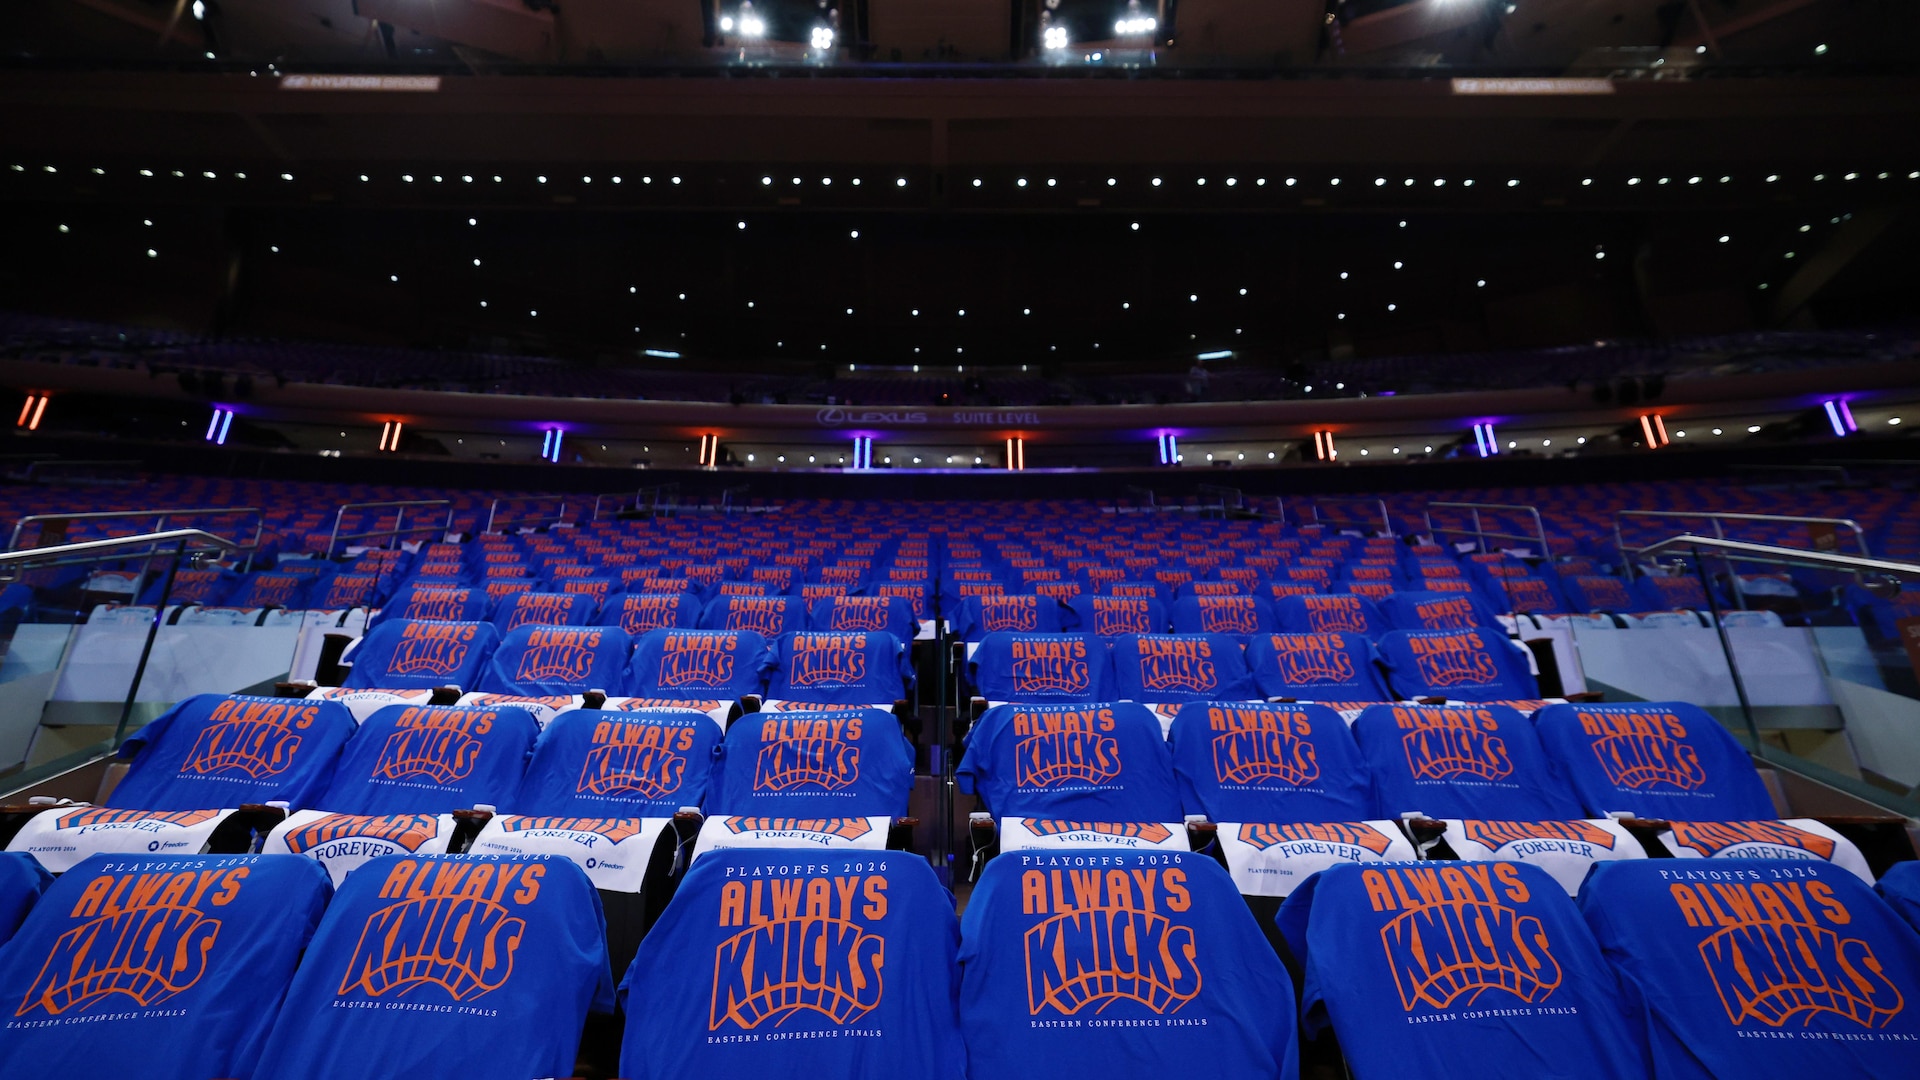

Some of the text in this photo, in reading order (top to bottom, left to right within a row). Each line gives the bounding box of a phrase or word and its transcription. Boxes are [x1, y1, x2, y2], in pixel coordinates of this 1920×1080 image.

[848, 412, 1040, 424] LEXUS SUITE LEVEL
[411, 590, 470, 603] ALWAYS
[516, 594, 574, 609] ALWAYS
[624, 597, 679, 610] ALWAYS
[729, 599, 786, 612] ALWAYS
[835, 595, 890, 607] ALWAYS
[981, 595, 1037, 607] ALWAYS
[1092, 599, 1149, 612] ALWAYS
[1199, 597, 1255, 610] ALWAYS
[1304, 597, 1361, 610] ALWAYS
[830, 605, 888, 632] KNICKS
[982, 604, 1037, 632] KNICKS
[1416, 600, 1473, 619] ALWAYS
[403, 623, 478, 641] ALWAYS
[527, 630, 601, 648] ALWAYS
[664, 635, 737, 651] ALWAYS
[793, 635, 866, 651] ALWAYS
[1271, 634, 1345, 651] ALWAYS
[1409, 632, 1484, 654] ALWAYS
[387, 636, 468, 675] KNICKS
[1012, 641, 1087, 658] ALWAYS
[1137, 638, 1211, 658] ALWAYS
[516, 643, 594, 682] KNICKS
[657, 647, 734, 687] KNICKS
[790, 647, 866, 686] KNICKS
[1012, 654, 1090, 693] KNICKS
[1140, 651, 1217, 692] KNICKS
[1277, 647, 1355, 685] KNICKS
[1416, 649, 1498, 686] KNICKS
[209, 700, 320, 729] ALWAYS
[1013, 705, 1076, 713] PLAYOFFS
[1207, 701, 1270, 711] PLAYOFFS
[395, 707, 497, 735] ALWAYS
[602, 715, 663, 726] PLAYOFFS
[761, 718, 863, 742] ALWAYS
[1013, 709, 1115, 736] ALWAYS
[1208, 707, 1312, 736] ALWAYS
[1392, 707, 1499, 731] ALWAYS
[1577, 712, 1687, 738] ALWAYS
[592, 721, 696, 751] ALWAYS
[180, 720, 302, 779] KNICKS
[372, 727, 483, 785] KNICKS
[1015, 730, 1122, 788] KNICKS
[1212, 728, 1321, 786] KNICKS
[1402, 725, 1513, 781] KNICKS
[1591, 732, 1707, 790] KNICKS
[576, 742, 687, 800] KNICKS
[753, 737, 860, 791] KNICKS
[79, 820, 167, 835] FOREVER
[525, 830, 598, 848] FOREVER
[755, 831, 832, 845] FOREVER
[1059, 834, 1137, 847] FOREVER
[1280, 842, 1361, 862] FOREVER
[1512, 839, 1593, 859] FOREVER
[101, 855, 260, 873] PLAYOFFS 2026
[726, 861, 888, 877] PLAYOFFS 2026
[1022, 855, 1182, 866] PLAYOFFS 2026
[378, 860, 547, 905] ALWAYS
[1659, 866, 1818, 881] PLAYOFFS 2026
[70, 866, 250, 918] ALWAYS
[1021, 867, 1192, 915] ALWAYS
[1361, 862, 1531, 912] ALWAYS
[719, 875, 888, 927] ALWAYS
[1669, 880, 1851, 927] ALWAYS
[337, 895, 526, 1002] KNICKS
[1380, 900, 1562, 1012] KNICKS
[14, 906, 222, 1016] KNICKS
[1023, 906, 1202, 1015] KNICKS
[708, 916, 885, 1031] KNICKS
[1697, 919, 1904, 1029] KNICKS
[6, 1009, 187, 1030] EASTERN CONFERENCE FINALS
[333, 1000, 498, 1017] EASTERN CONFERENCE FINALS
[1407, 1007, 1578, 1024] EASTERN CONFERENCE FINALS
[1031, 1018, 1208, 1028] EASTERN CONFERENCE FINALS
[708, 1029, 882, 1044] EASTERN CONFERENCE FINALS
[1737, 1030, 1795, 1039] EASTERN
[1801, 1032, 1874, 1041] CONFERENCE
